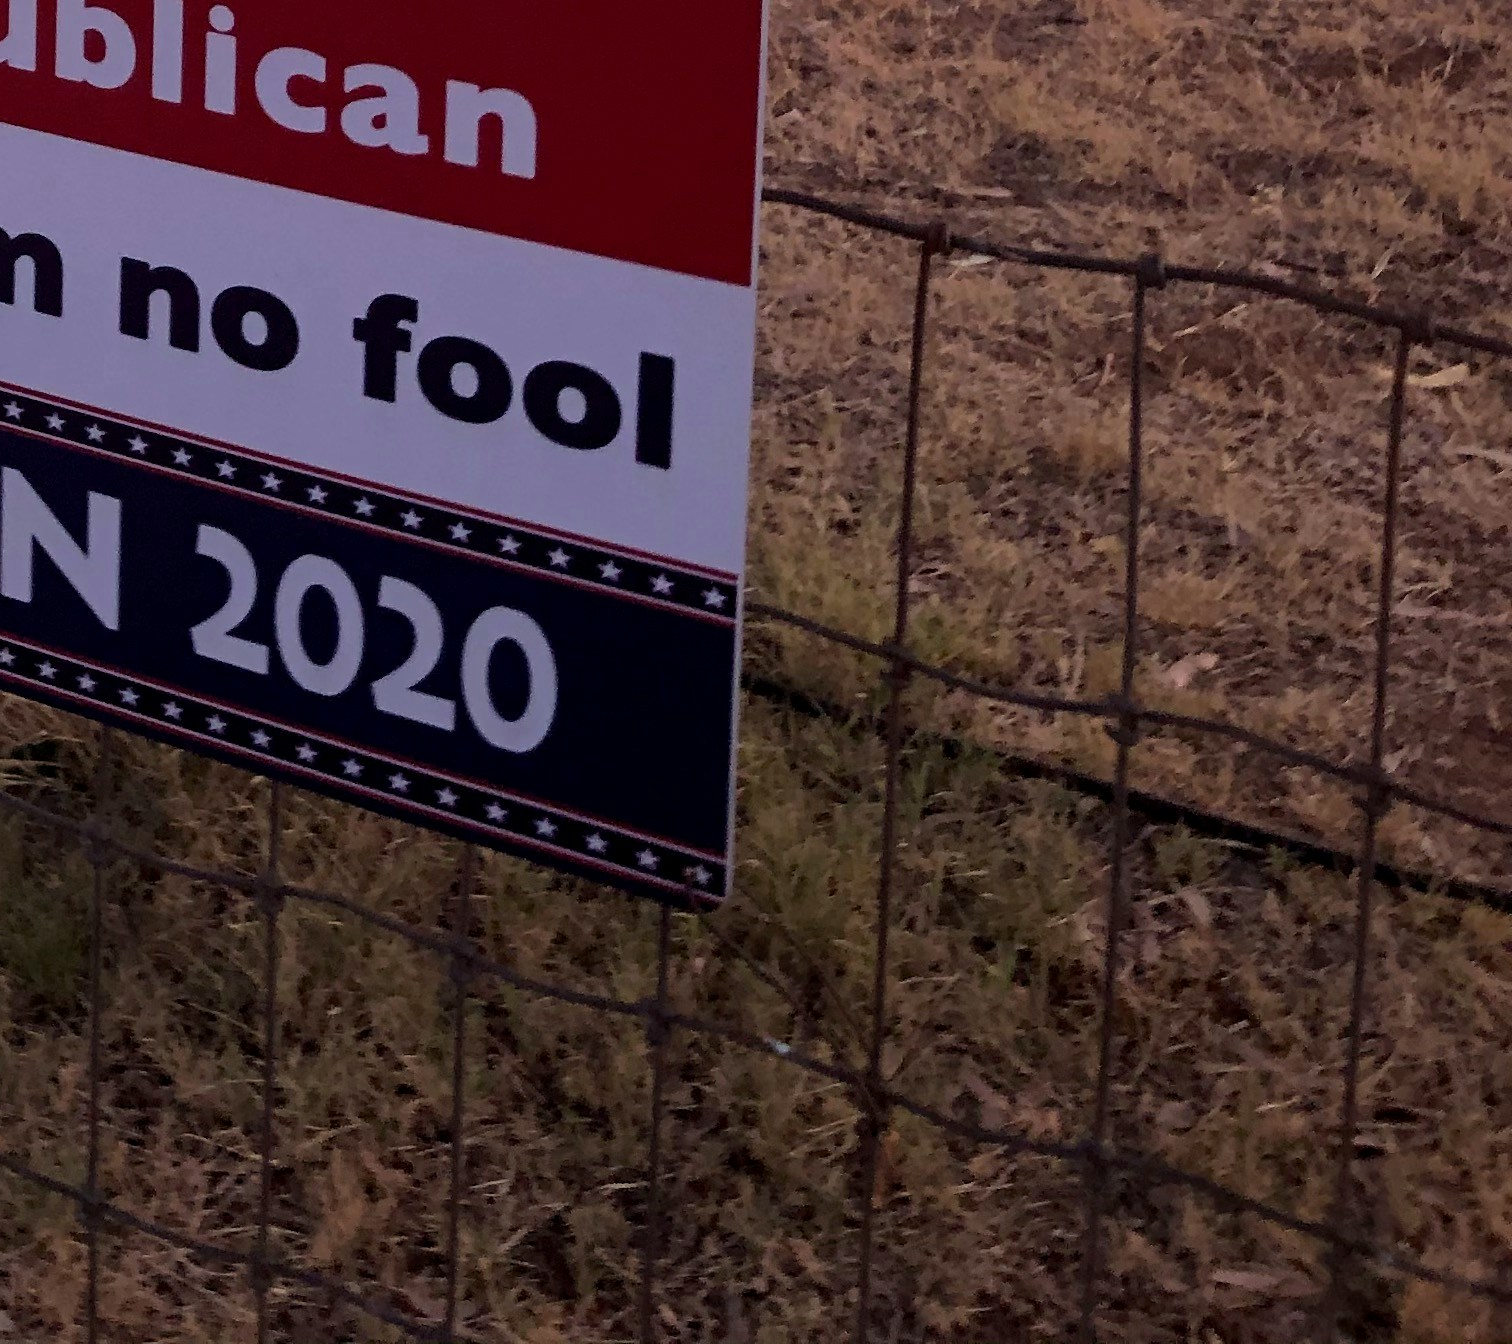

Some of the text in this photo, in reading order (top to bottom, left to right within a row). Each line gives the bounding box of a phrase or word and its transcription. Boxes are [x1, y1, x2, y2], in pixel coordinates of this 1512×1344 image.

[119, 257, 299, 372] no
[353, 294, 675, 471] fool
[192, 525, 558, 752] 2020
